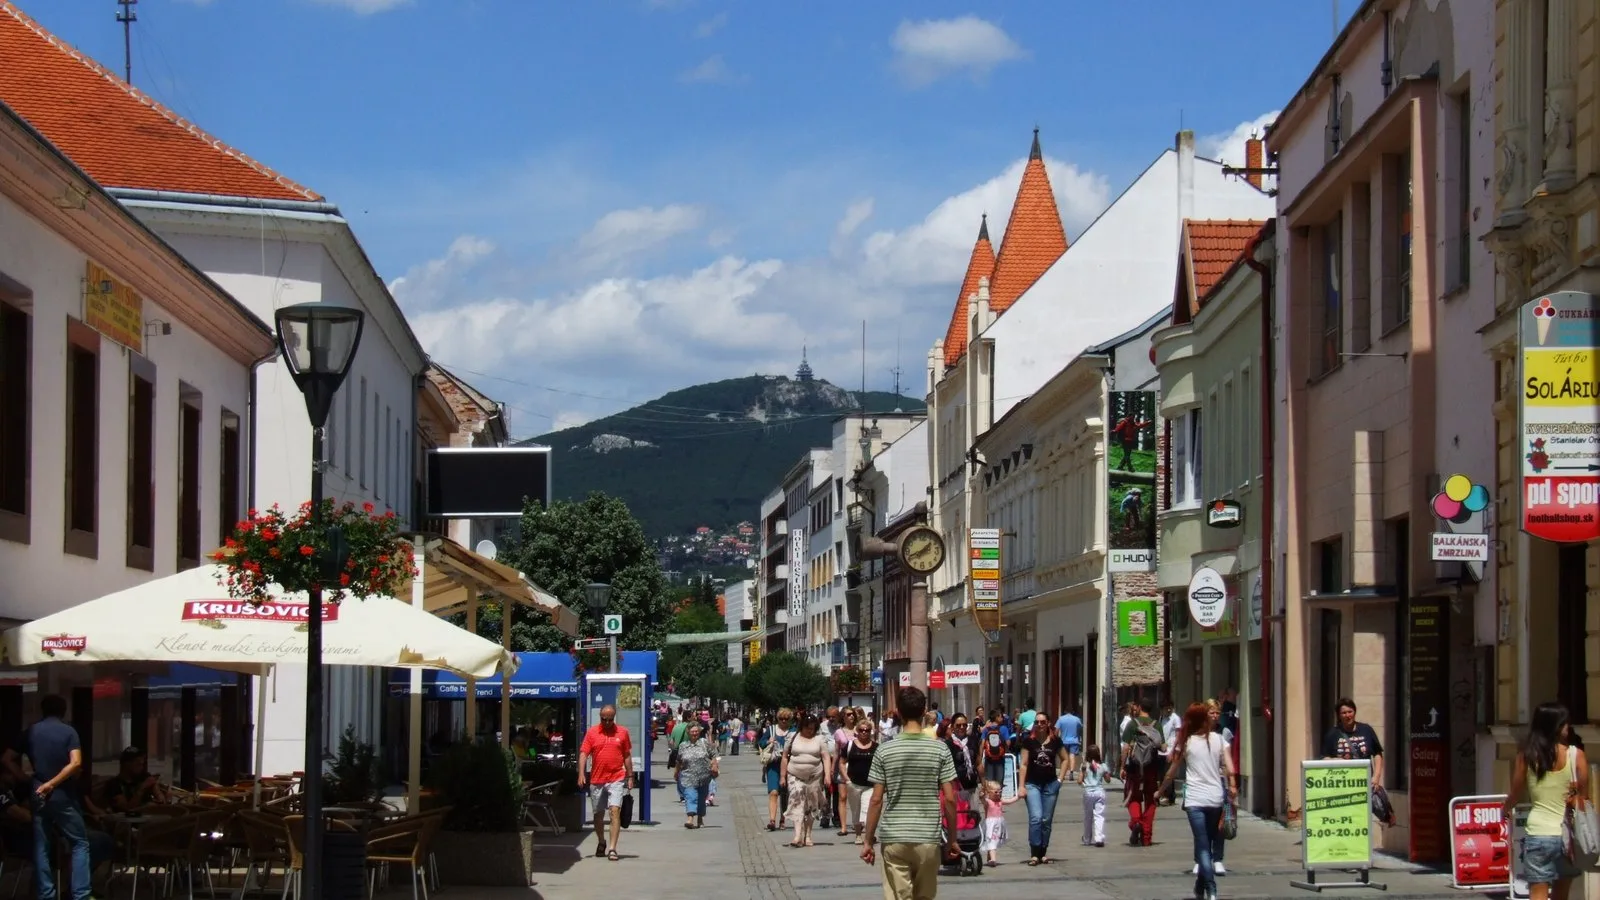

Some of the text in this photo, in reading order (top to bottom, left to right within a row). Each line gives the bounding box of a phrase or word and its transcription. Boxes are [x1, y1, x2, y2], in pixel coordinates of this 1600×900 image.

[1550, 436, 1587, 444] Stanislav
[1527, 478, 1551, 509] pd
[1528, 513, 1593, 524] footballshop.sk
[1433, 536, 1486, 546] BALKÁNSKA
[1438, 549, 1480, 557] ZMRZLINA
[43, 639, 84, 648] KRUŠOVICE
[155, 632, 207, 654] Klenot
[321, 642, 362, 655] ivami
[1305, 777, 1368, 789] Solárium
[1322, 816, 1353, 825] Po-Pi
[1455, 806, 1470, 827] pd
[1306, 828, 1369, 838] 8.00-20.00
